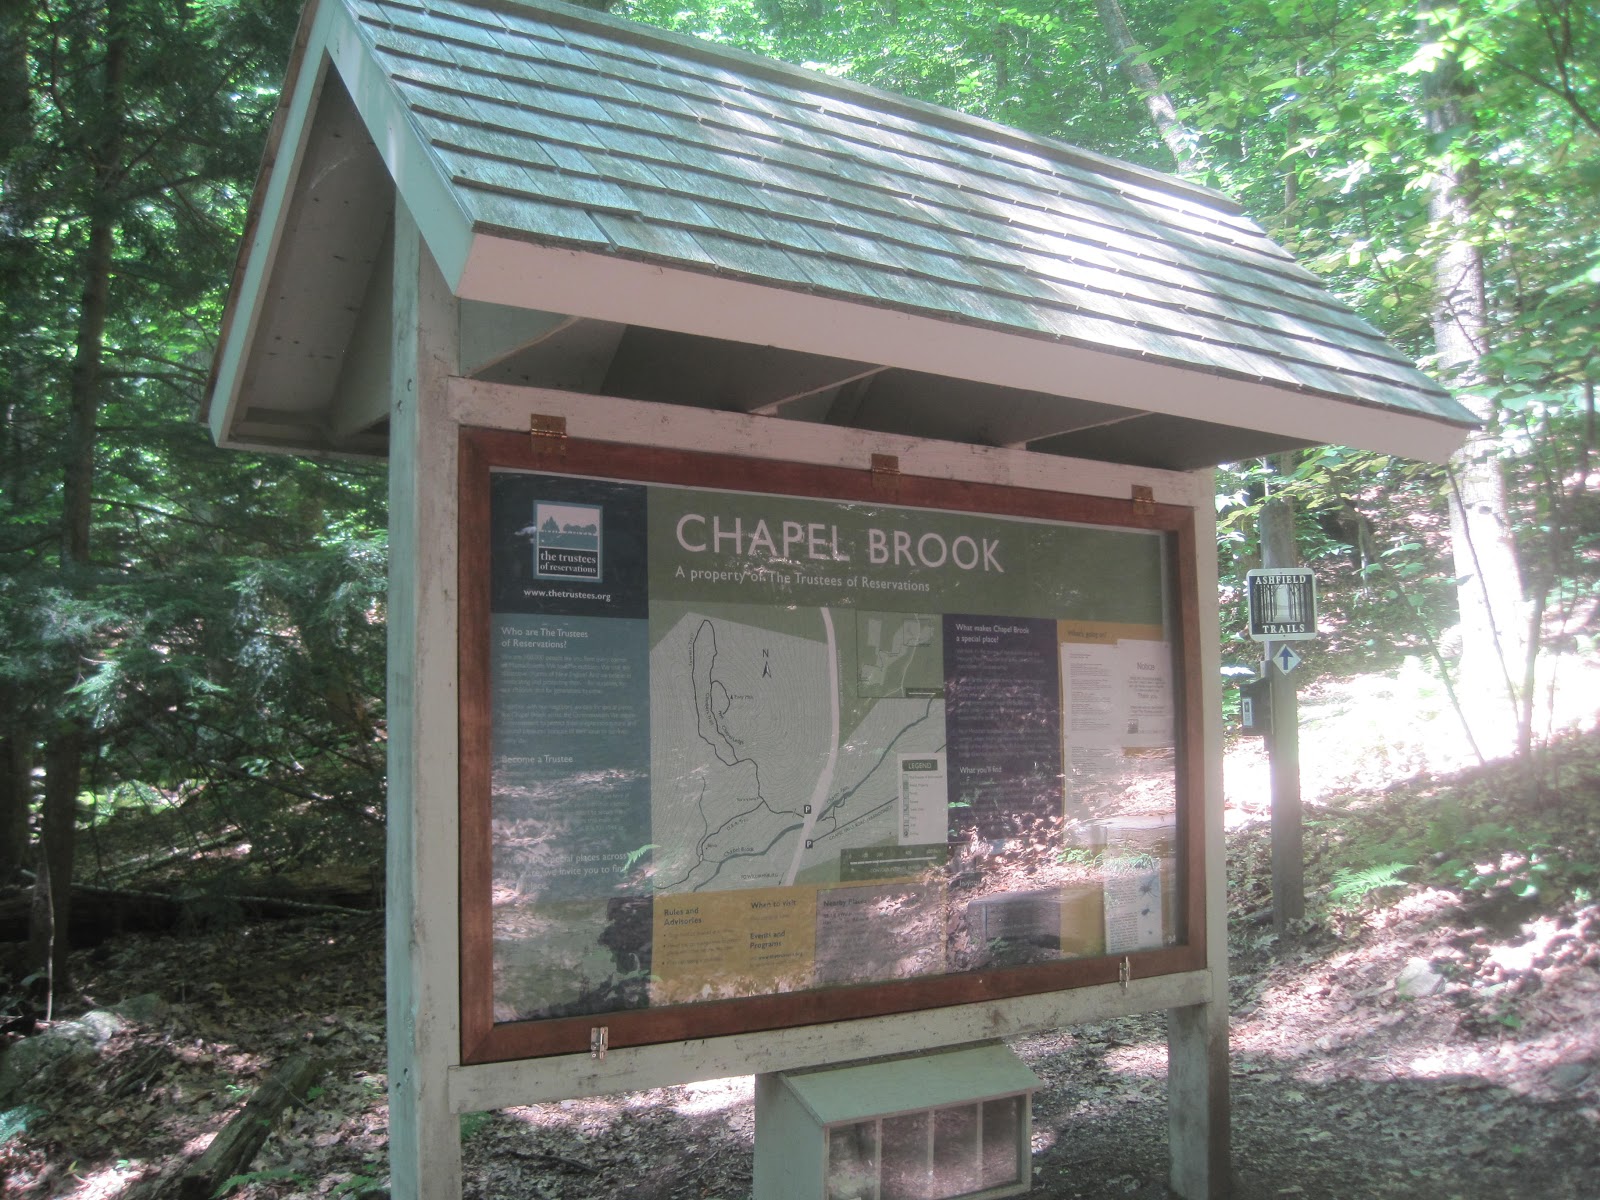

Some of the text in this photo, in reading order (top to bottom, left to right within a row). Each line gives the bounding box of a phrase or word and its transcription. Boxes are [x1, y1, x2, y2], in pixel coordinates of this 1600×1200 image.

[676, 513, 1004, 573] CHAPEL BROOK
[540, 550, 596, 564] the trustees
[540, 562, 596, 573] of reservations
[675, 566, 685, 578] A
[690, 569, 745, 584] property
[769, 571, 791, 584] The
[796, 572, 842, 587] Trustees
[847, 575, 857, 587] of
[862, 576, 930, 592] Reservations
[1255, 575, 1307, 585] ASHFIELD
[523, 589, 611, 602] www.thetrustees.org
[501, 627, 522, 636] Who
[540, 628, 555, 637] The
[557, 628, 588, 638] Trustees
[956, 623, 972, 631] What
[993, 625, 1012, 634] Chapel
[1013, 626, 1029, 634] Brook
[1262, 623, 1305, 634] TRAILS
[501, 639, 567, 648] of Reservations?
[961, 635, 980, 644] special
[762, 649, 769, 658] N
[501, 755, 534, 763] Become
[544, 755, 573, 763] Trustee
[575, 853, 600, 863] places
[602, 853, 626, 861] across
[560, 867, 581, 876] invite
[584, 868, 598, 876] you
[751, 901, 772, 909] When
[823, 899, 846, 907] Nearby
[685, 907, 699, 915] and
[664, 917, 702, 926] Advisories
[751, 930, 785, 940] Events and
[750, 940, 782, 949] Programs
